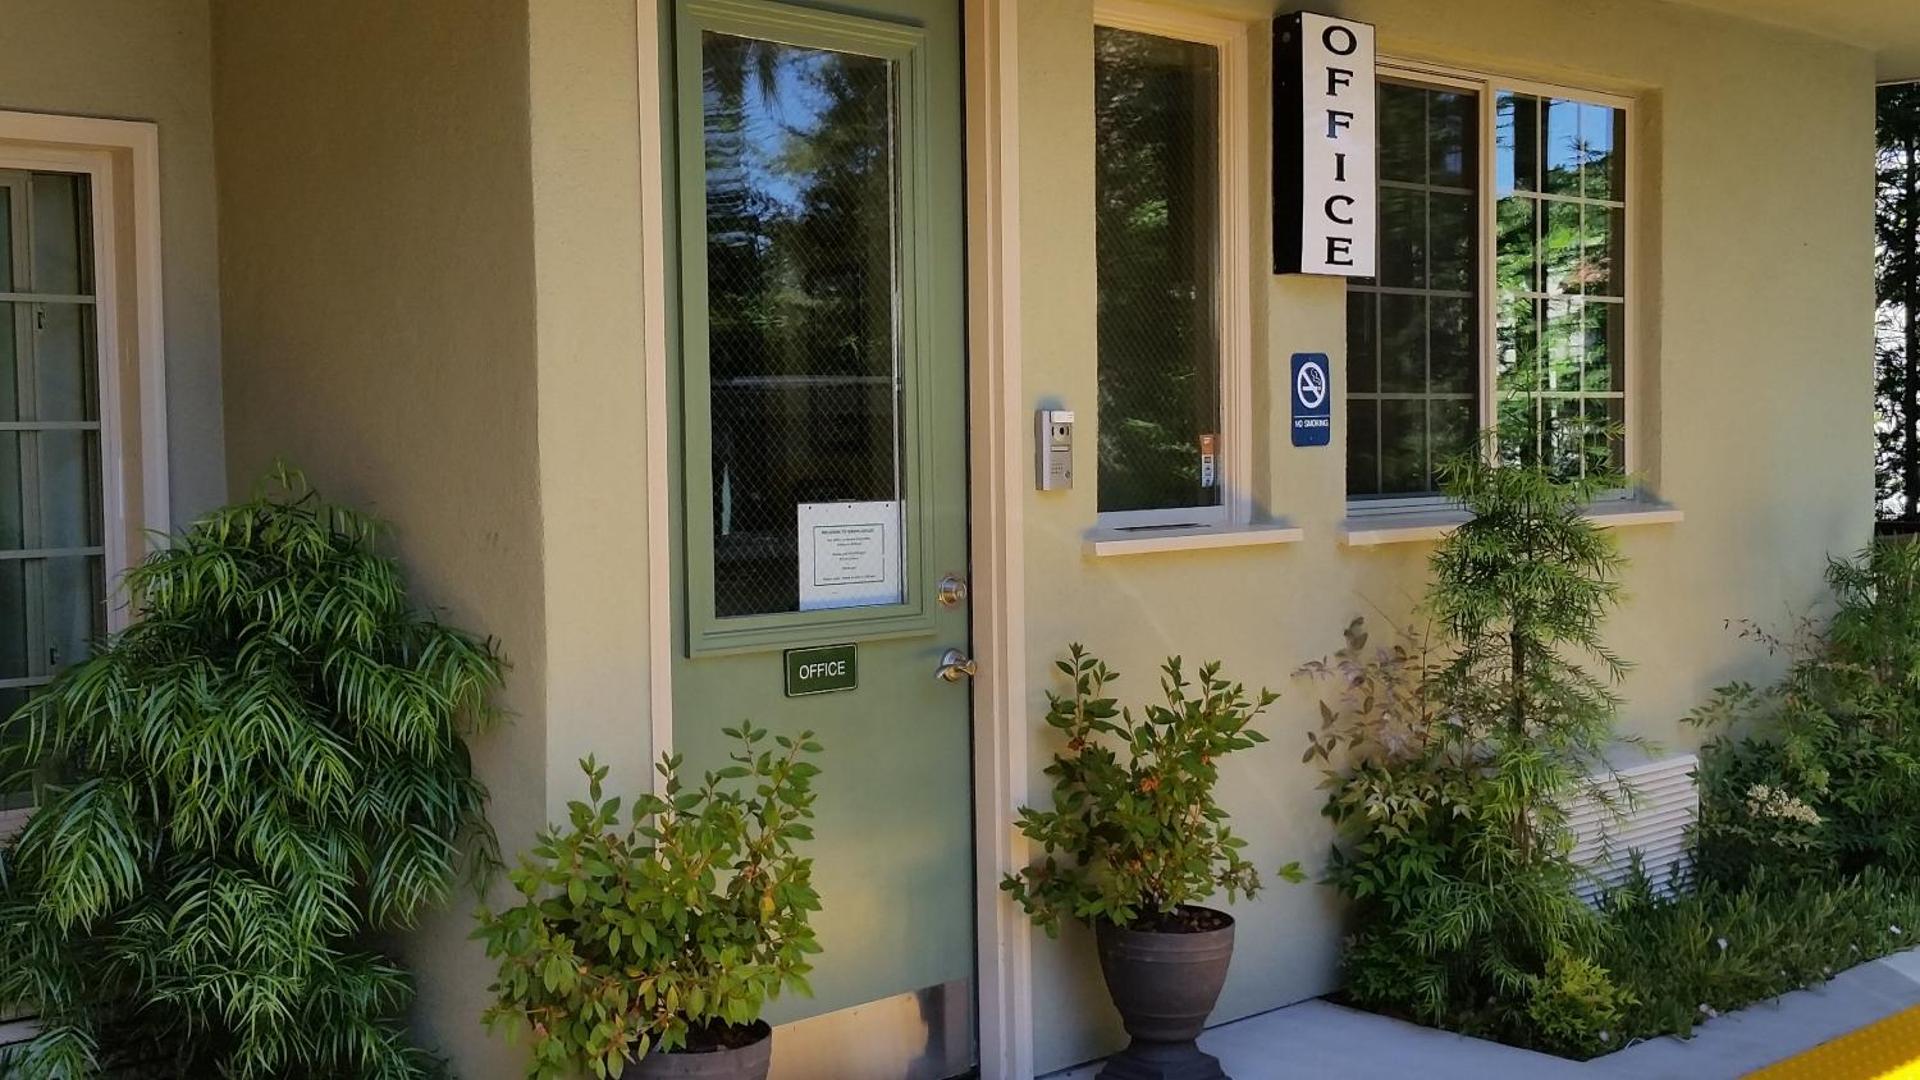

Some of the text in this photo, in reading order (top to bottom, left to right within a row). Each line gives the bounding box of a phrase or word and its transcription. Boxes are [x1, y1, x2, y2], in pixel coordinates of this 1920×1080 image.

[1321, 25, 1358, 267] OFFICE
[1294, 419, 1329, 428] NO SMOKING
[800, 660, 846, 680] OFFICE
